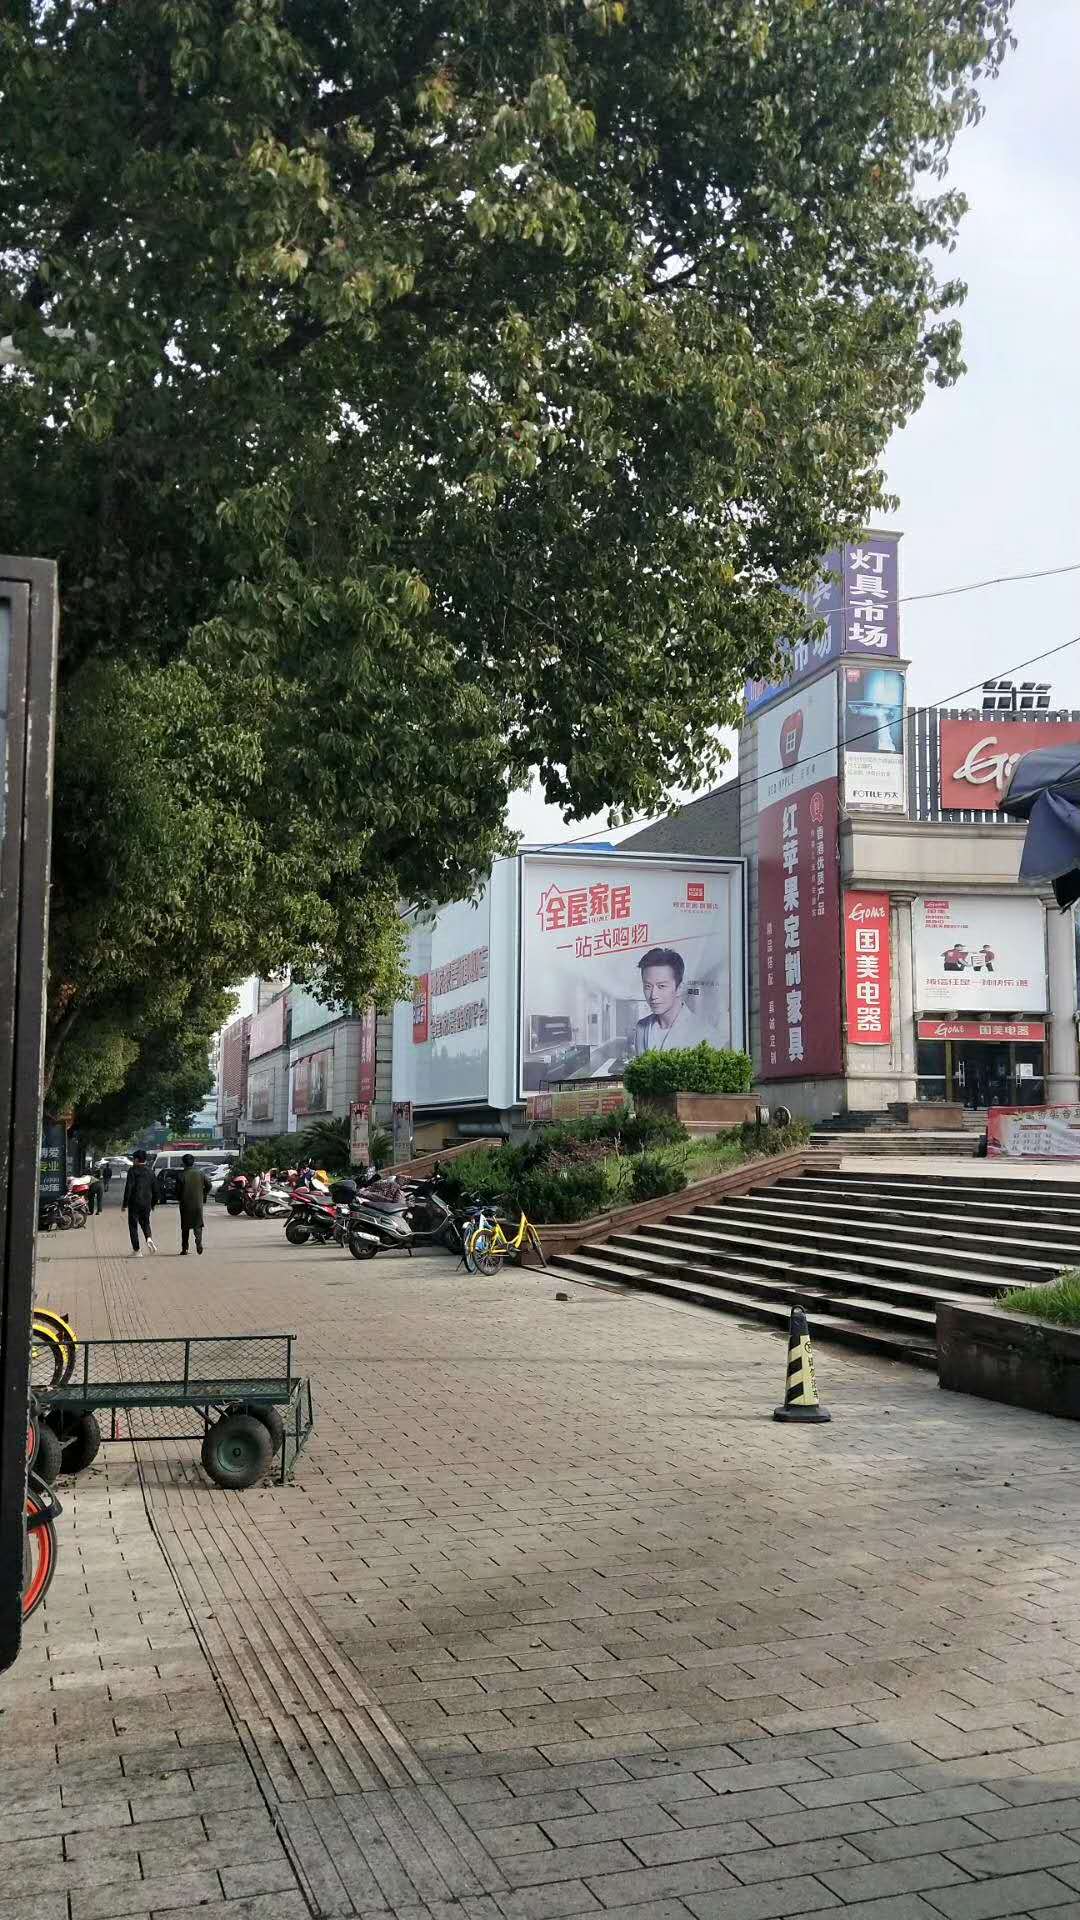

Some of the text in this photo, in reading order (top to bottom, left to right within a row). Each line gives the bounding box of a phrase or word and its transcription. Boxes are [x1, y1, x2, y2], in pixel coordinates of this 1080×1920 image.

[848, 548, 890, 648] 灯具市场
[545, 883, 631, 931] 全屋家居
[556, 923, 648, 958] 一站式购物
[783, 803, 803, 1063] 红苹果定制家具
[855, 928, 881, 1031] 国美电器
[979, 1025, 1029, 1036] 国美电器
